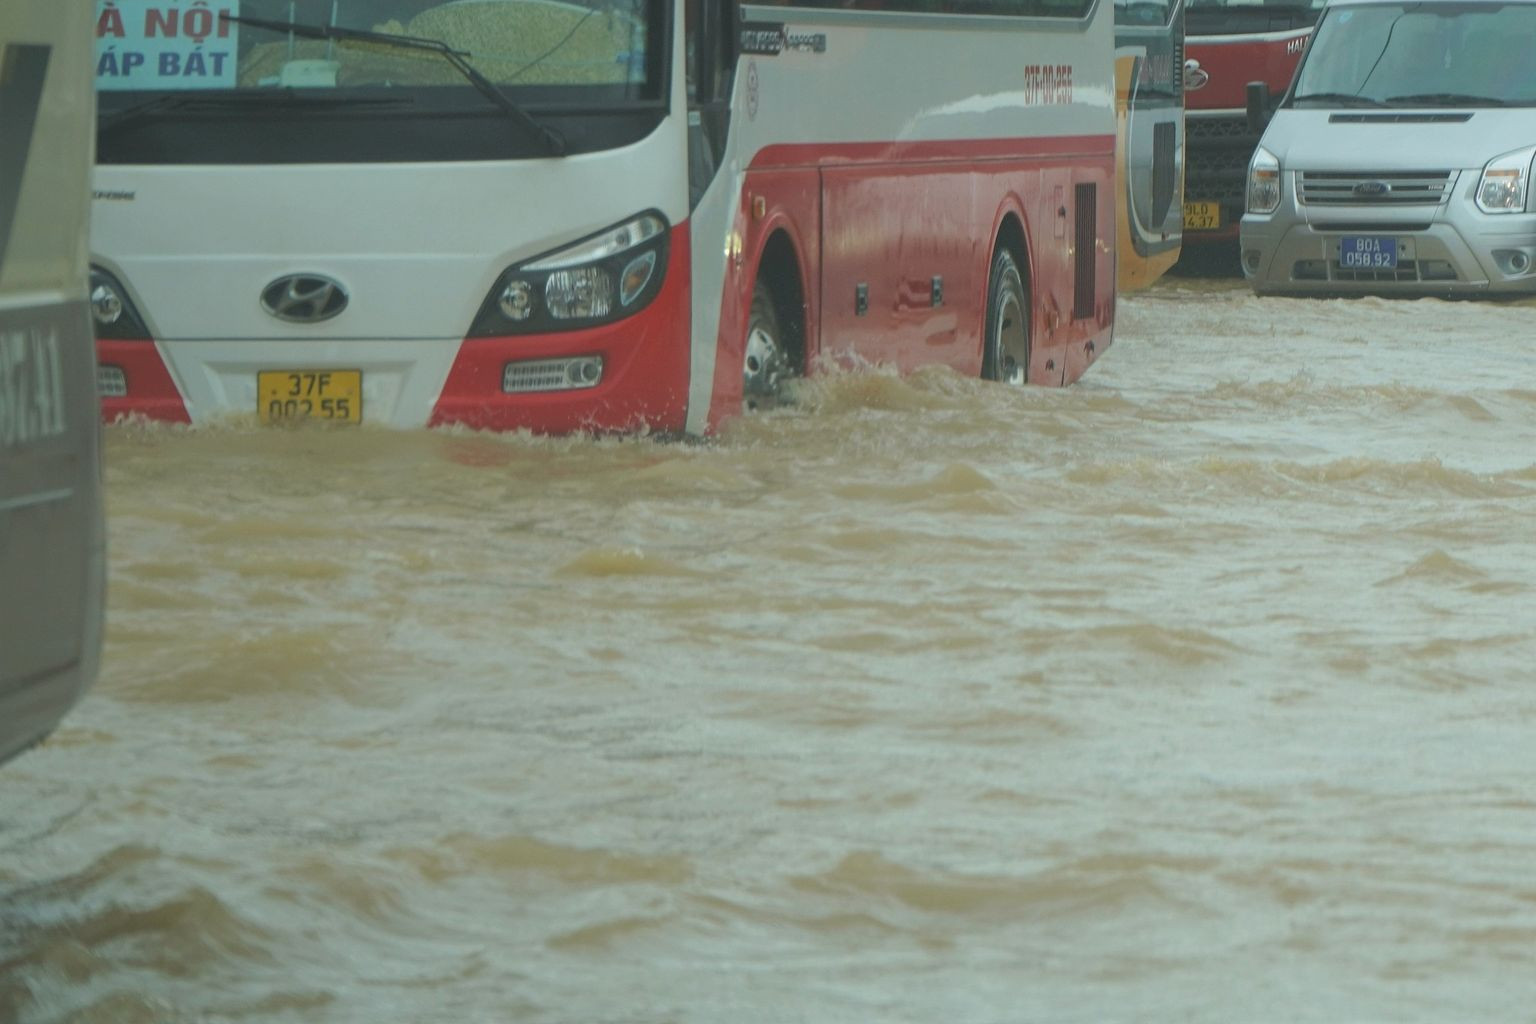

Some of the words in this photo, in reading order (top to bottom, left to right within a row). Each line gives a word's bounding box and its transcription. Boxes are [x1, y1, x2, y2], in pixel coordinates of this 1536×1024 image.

[144, 0, 230, 44] NỘI
[158, 45, 230, 77] BÁT
[1356, 239, 1381, 253] 80A
[1346, 252, 1391, 267] 058.92
[287, 373, 333, 397] 37F
